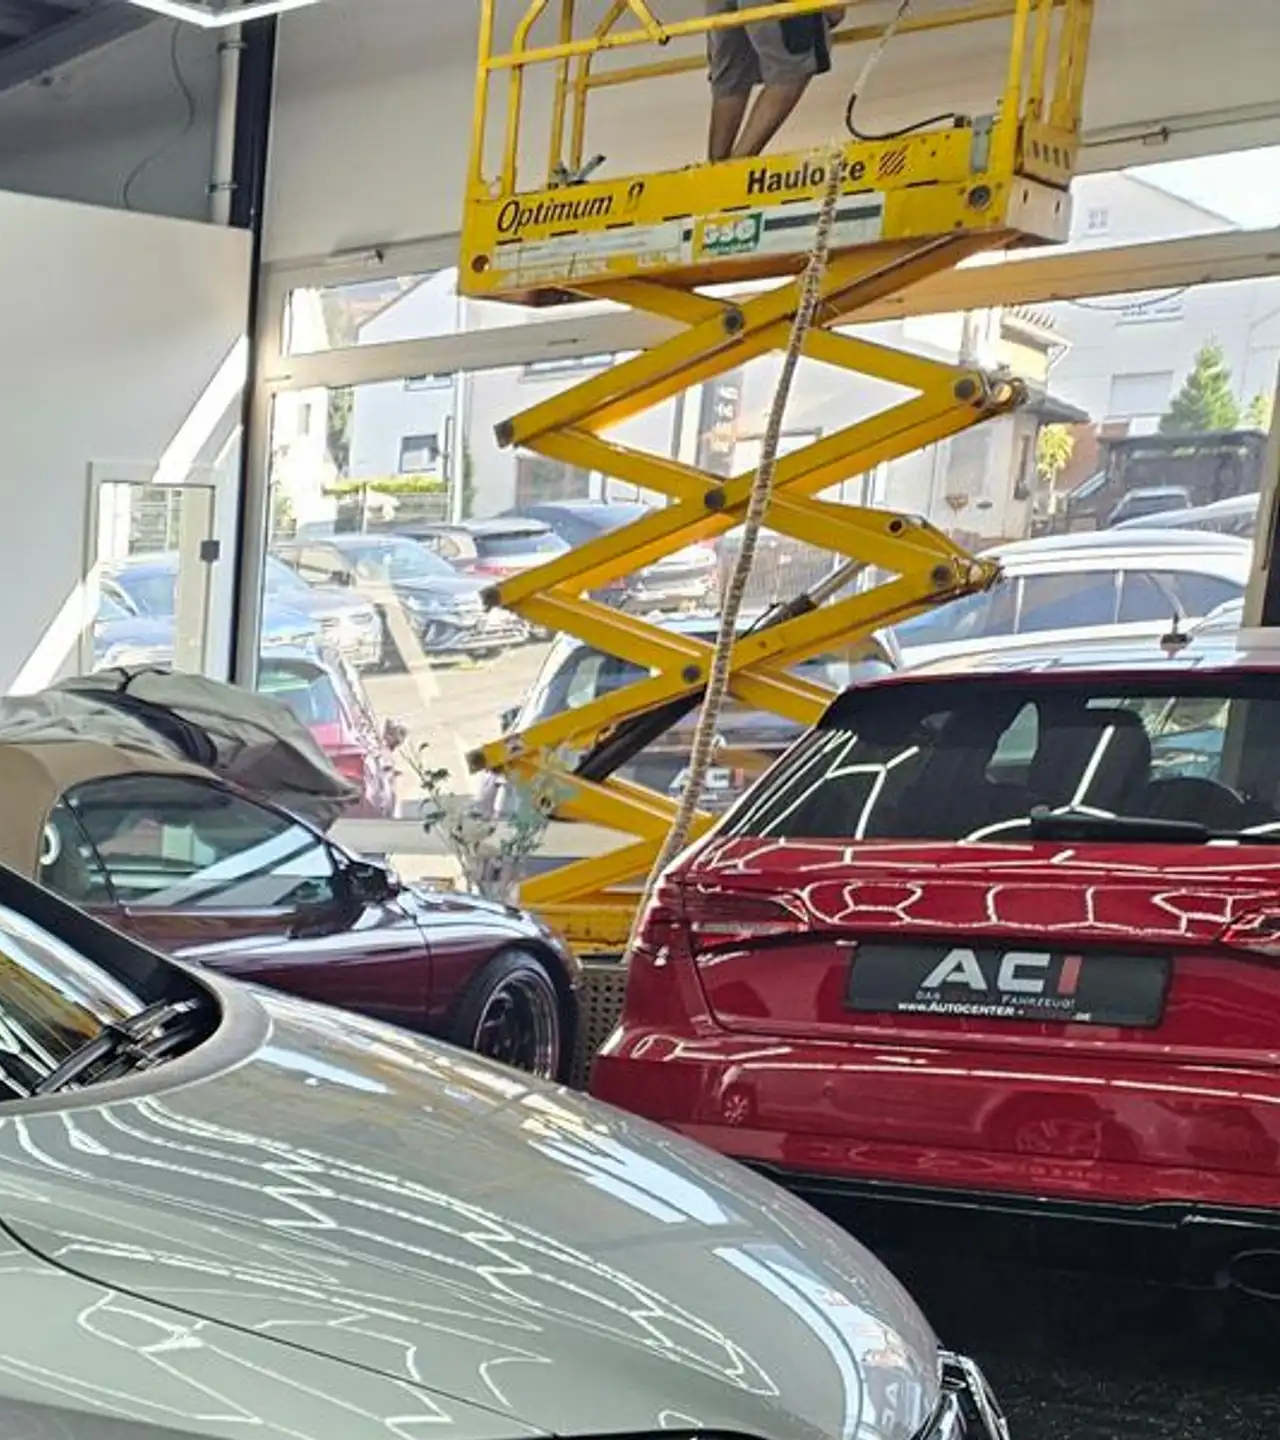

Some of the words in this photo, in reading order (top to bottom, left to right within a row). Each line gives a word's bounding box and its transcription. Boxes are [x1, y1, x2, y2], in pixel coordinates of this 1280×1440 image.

[746, 159, 868, 195] Hauloe
[496, 194, 614, 235] Optimum
[920, 948, 1082, 994] ACI
